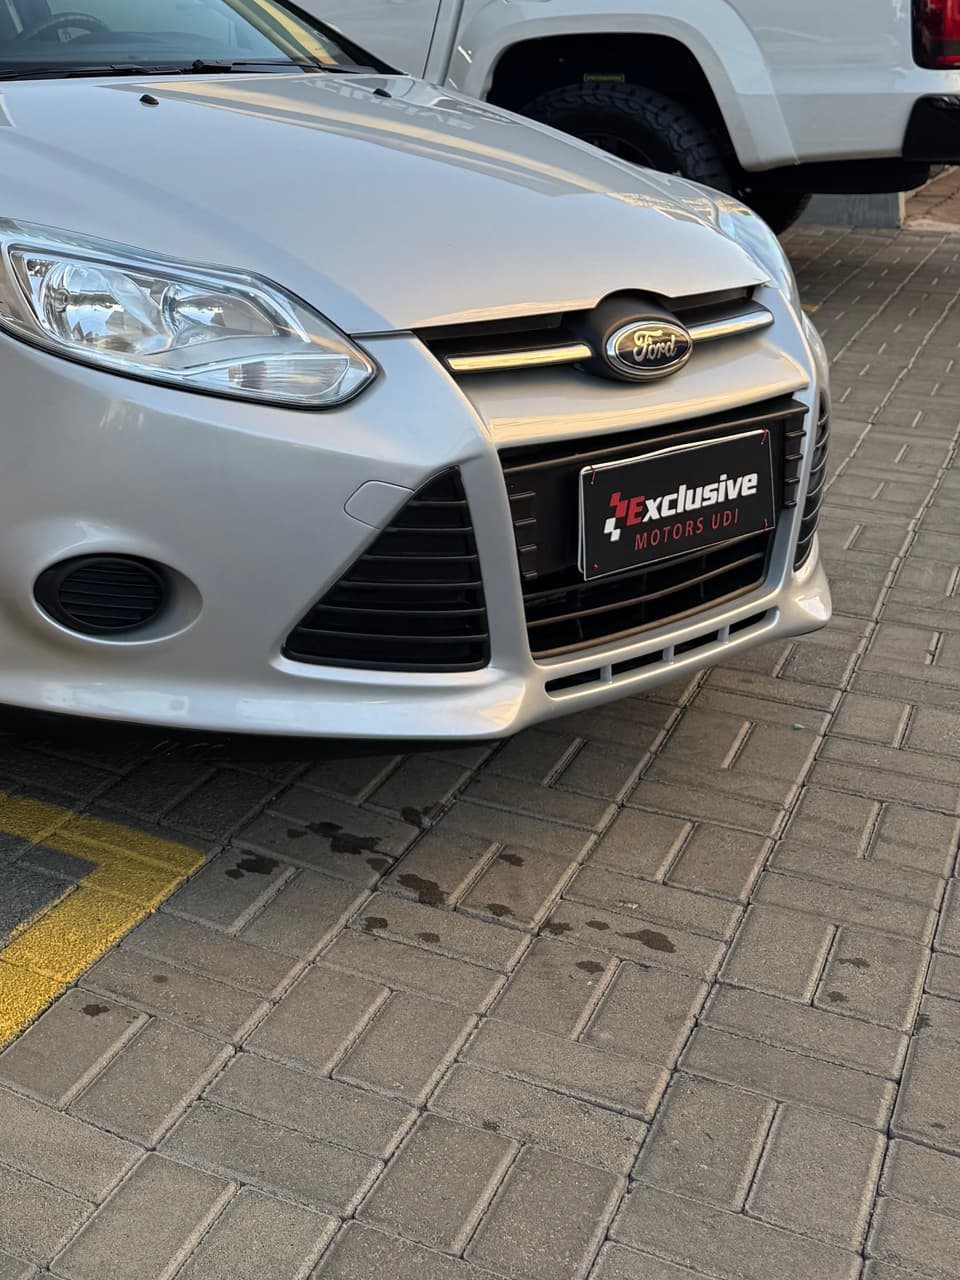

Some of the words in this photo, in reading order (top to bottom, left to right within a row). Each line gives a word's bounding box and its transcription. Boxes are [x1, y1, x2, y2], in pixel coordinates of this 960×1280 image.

[633, 330, 677, 362] Ford
[626, 472, 759, 527] Exclusive
[634, 516, 704, 552] MOTORS
[711, 507, 739, 530] UDI
